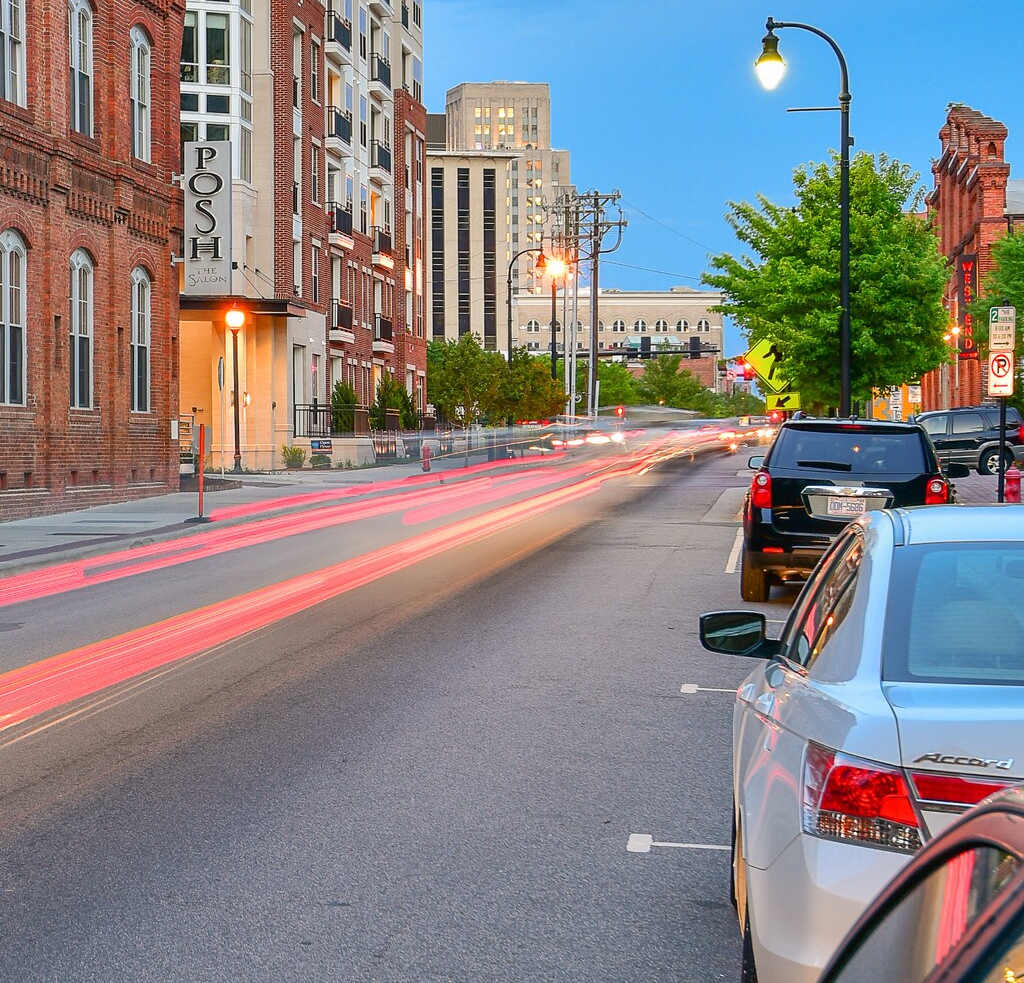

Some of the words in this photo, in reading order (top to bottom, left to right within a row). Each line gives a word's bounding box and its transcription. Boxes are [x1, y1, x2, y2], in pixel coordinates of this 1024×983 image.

[188, 147, 224, 260] POSH
[196, 267, 217, 275] THE
[962, 262, 974, 303] WES
[991, 310, 998, 322] 2
[964, 315, 974, 349] END
[913, 753, 1014, 770] Accord
